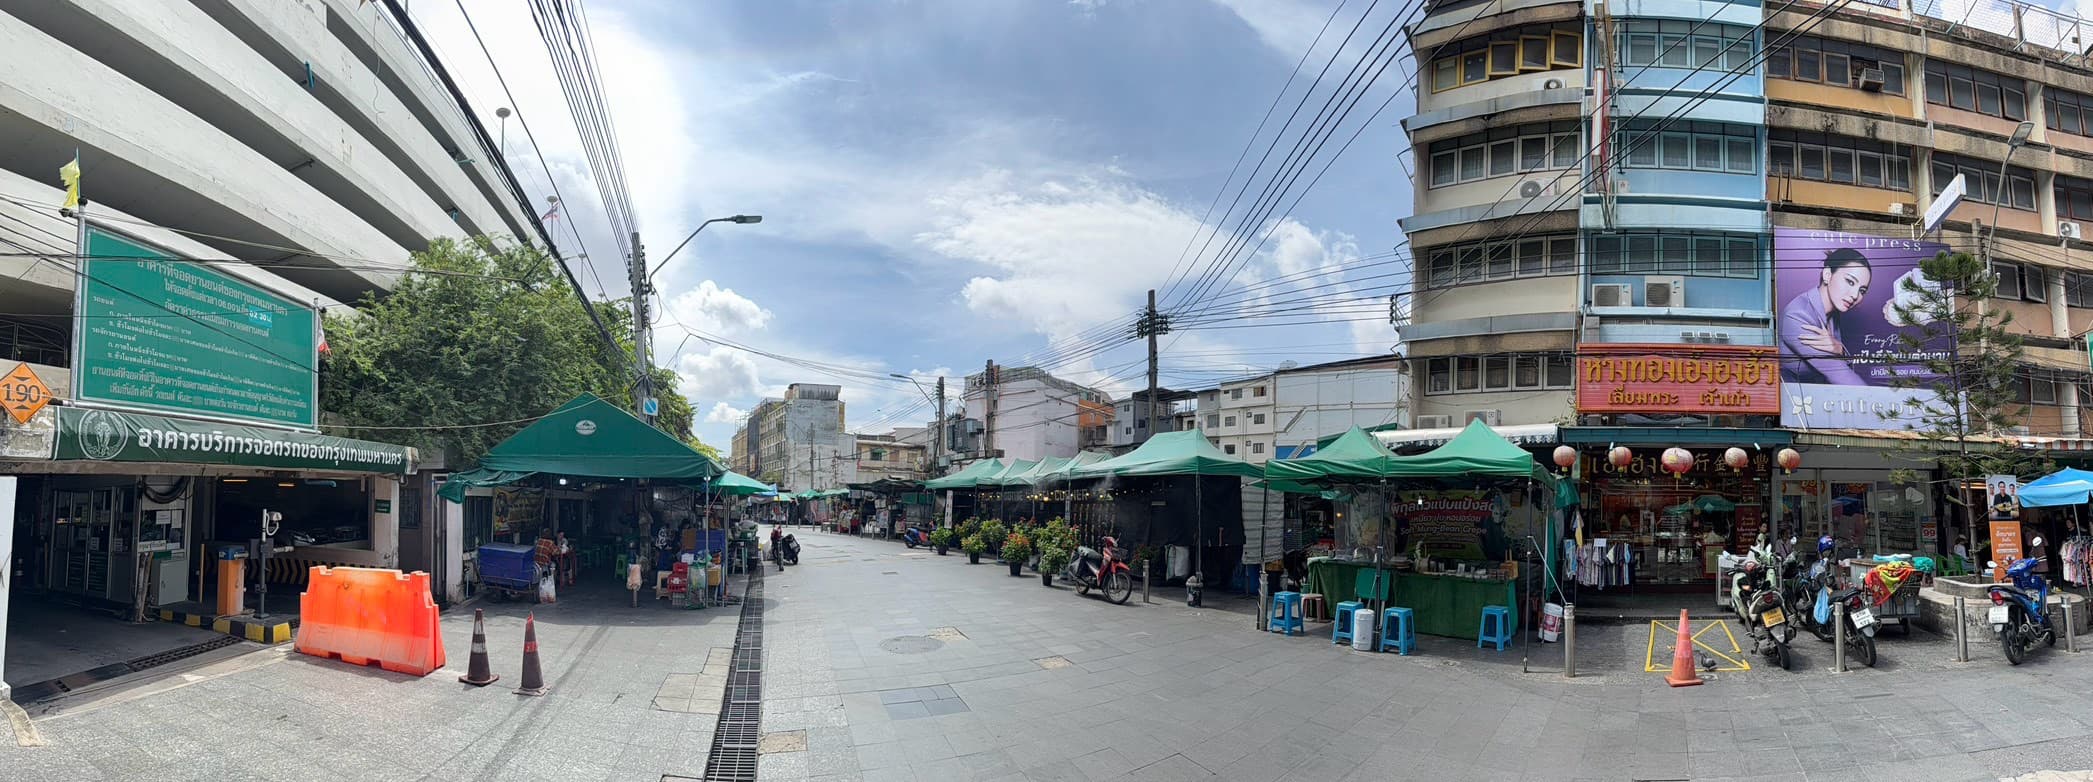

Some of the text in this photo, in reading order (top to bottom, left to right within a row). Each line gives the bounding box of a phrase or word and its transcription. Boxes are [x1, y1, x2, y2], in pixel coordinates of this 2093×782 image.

[1865, 238, 1922, 252] press
[2, 383, 40, 404] 1.90
[1608, 384, 1751, 407] เลี่ยมพระ เจ้าเก่า
[1823, 399, 1885, 414] cute
[138, 428, 402, 466] อาคารบริการจอดรถของกรุงเทพมหานคร
